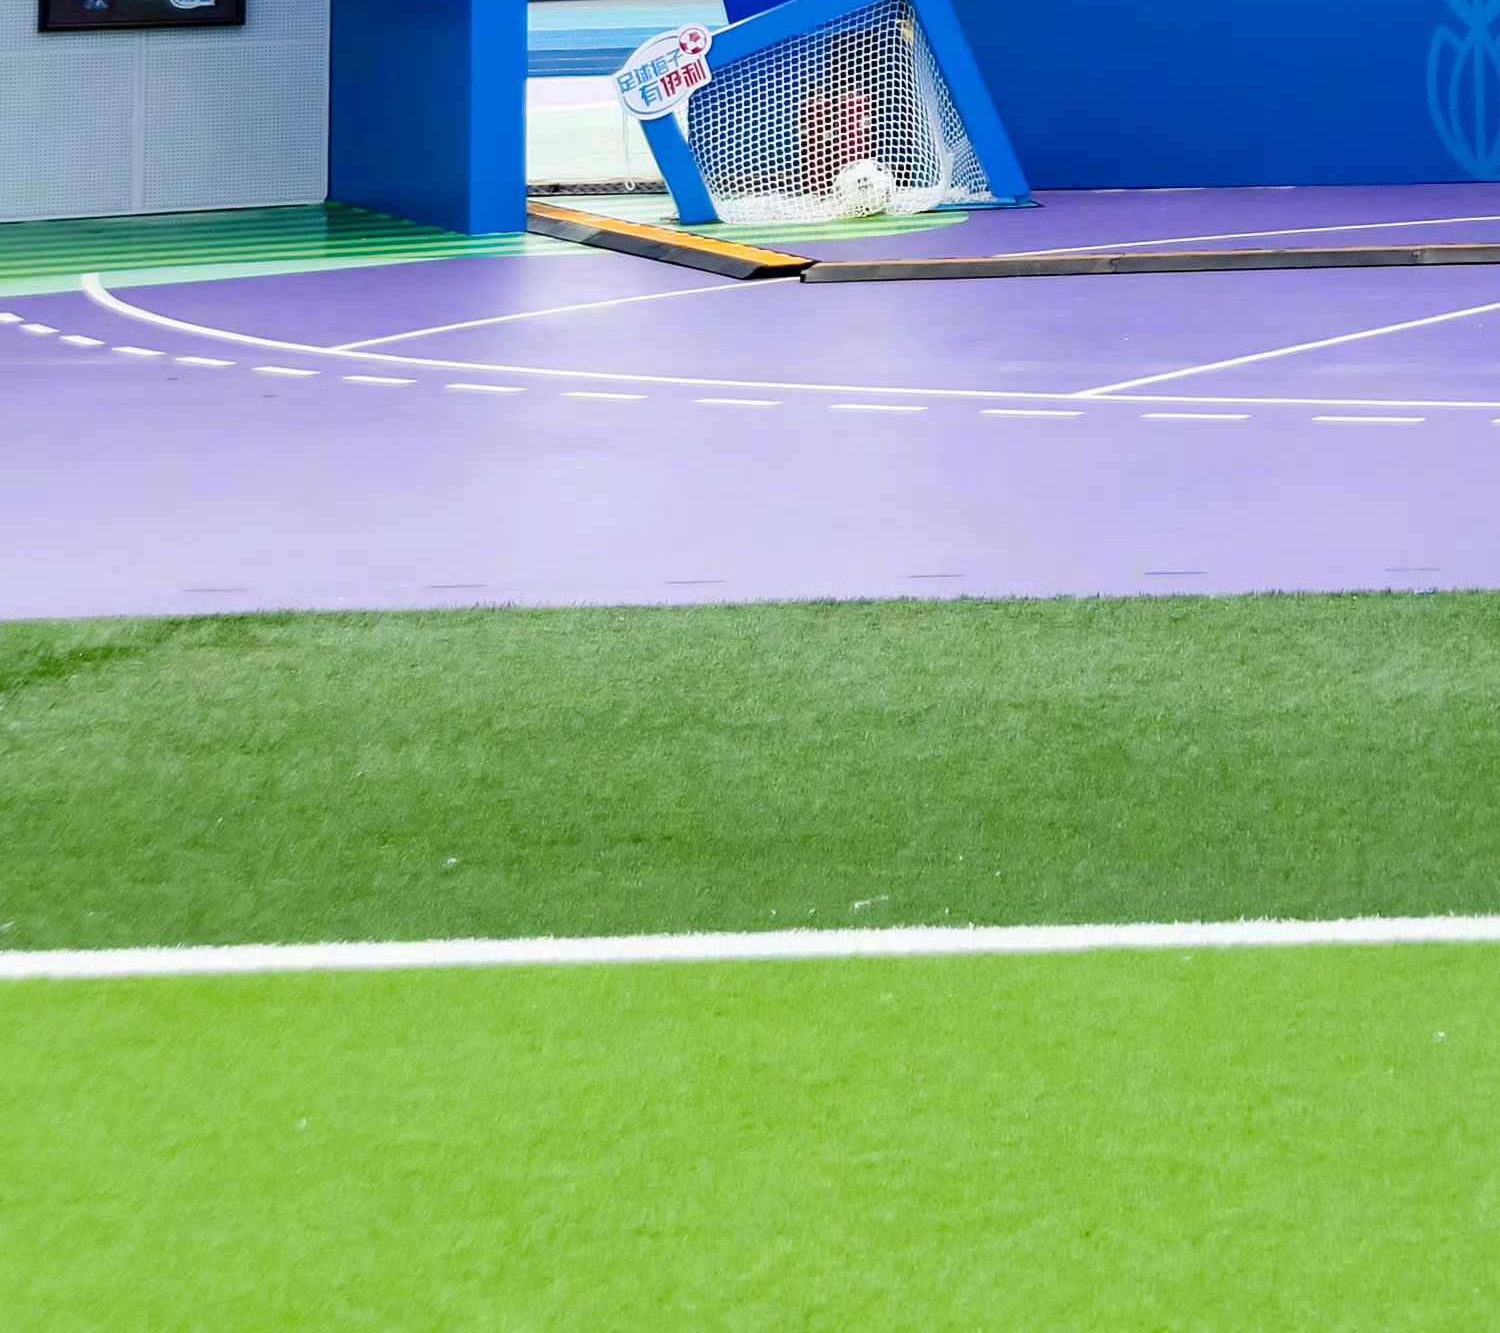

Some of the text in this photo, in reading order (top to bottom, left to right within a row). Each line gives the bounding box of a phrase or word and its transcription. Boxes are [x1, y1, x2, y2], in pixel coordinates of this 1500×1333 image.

[617, 48, 683, 95] 足球搭子
[640, 58, 707, 107] 有伊利
